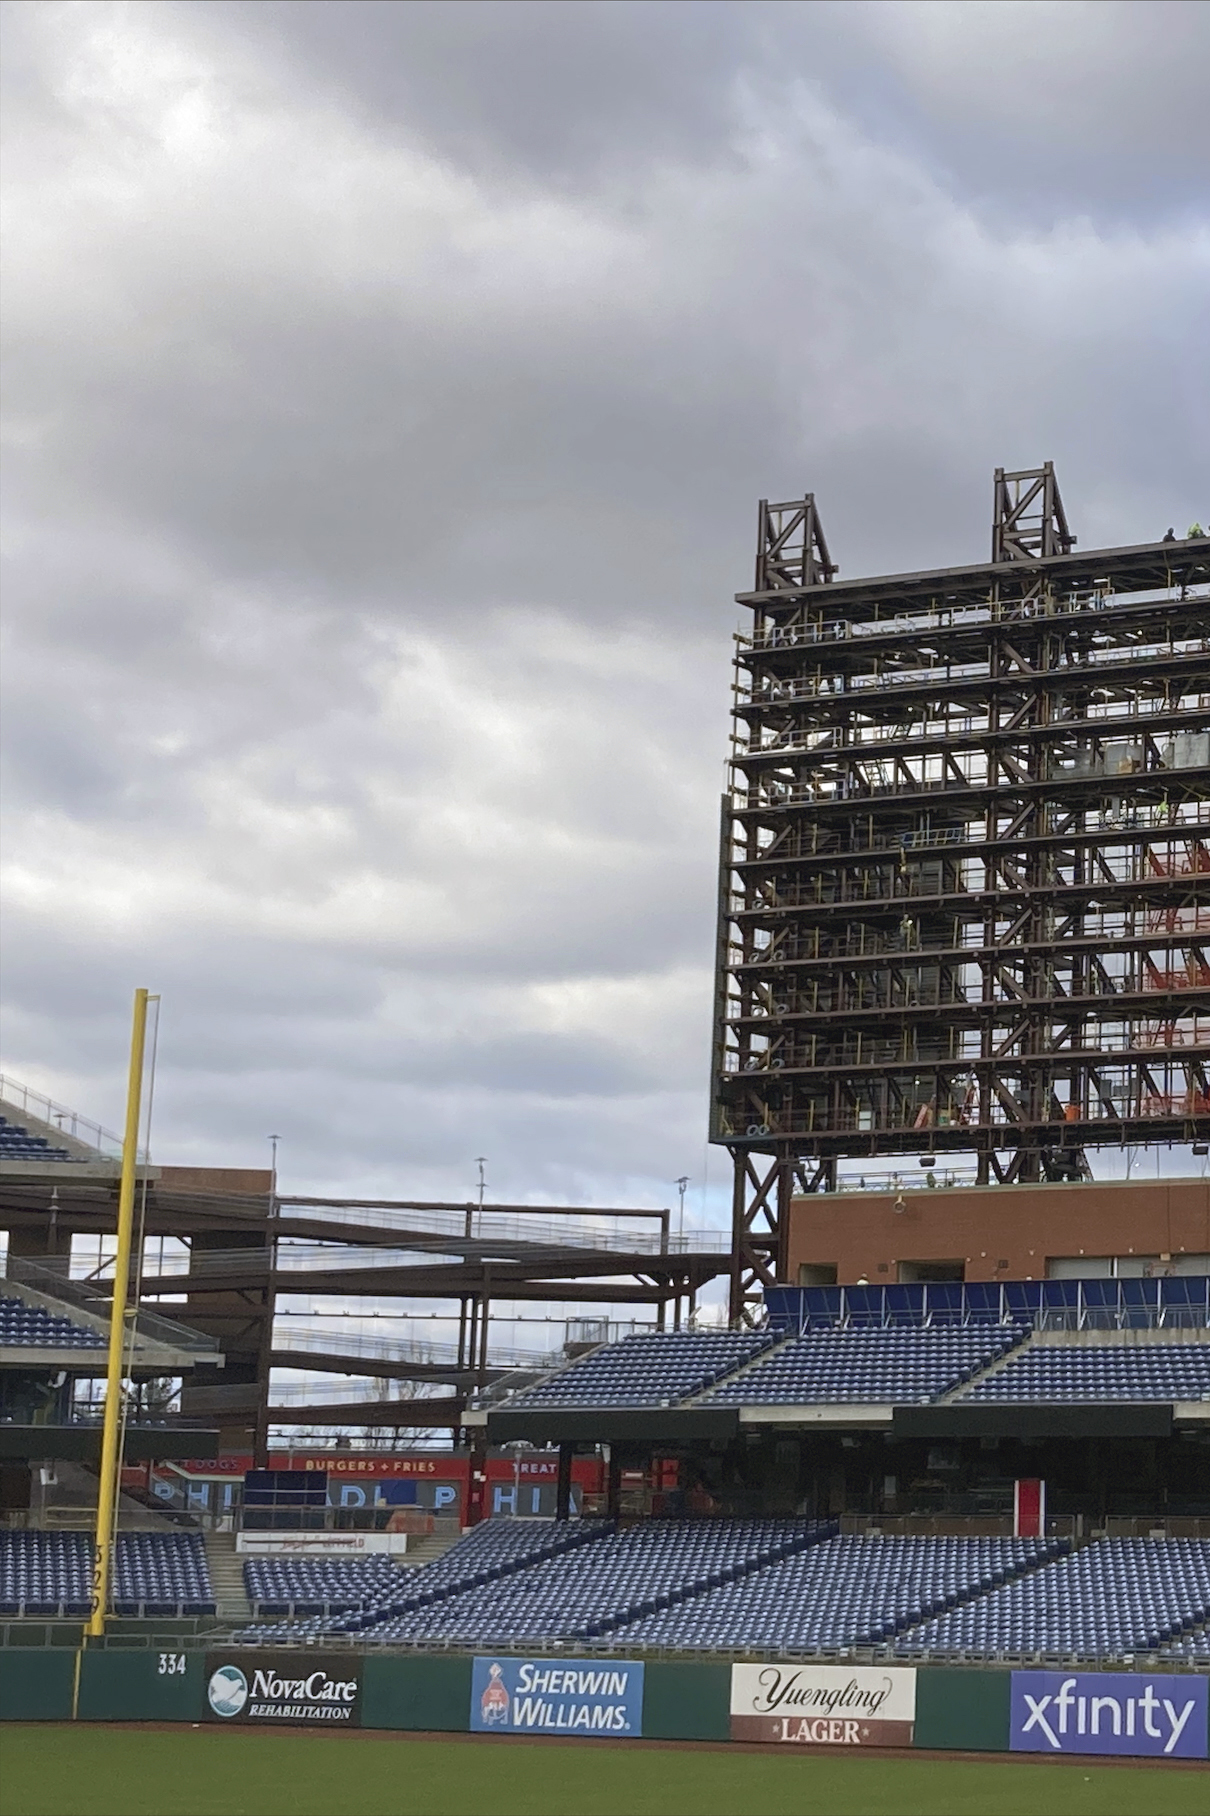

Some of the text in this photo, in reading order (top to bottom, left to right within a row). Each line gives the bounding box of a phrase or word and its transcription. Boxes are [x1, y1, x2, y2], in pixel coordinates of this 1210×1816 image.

[305, 1459, 375, 1472] BURGERS
[393, 1461, 436, 1473] FRIES
[158, 1653, 186, 1675] 334
[249, 1669, 358, 1702] NovaCare
[515, 1663, 628, 1697] SHERWIN
[752, 1667, 893, 1717] Yuengling
[248, 1704, 353, 1720] REHABILITATION
[1021, 1678, 1196, 1753] xfinity
[780, 1718, 861, 1744] LAGER
